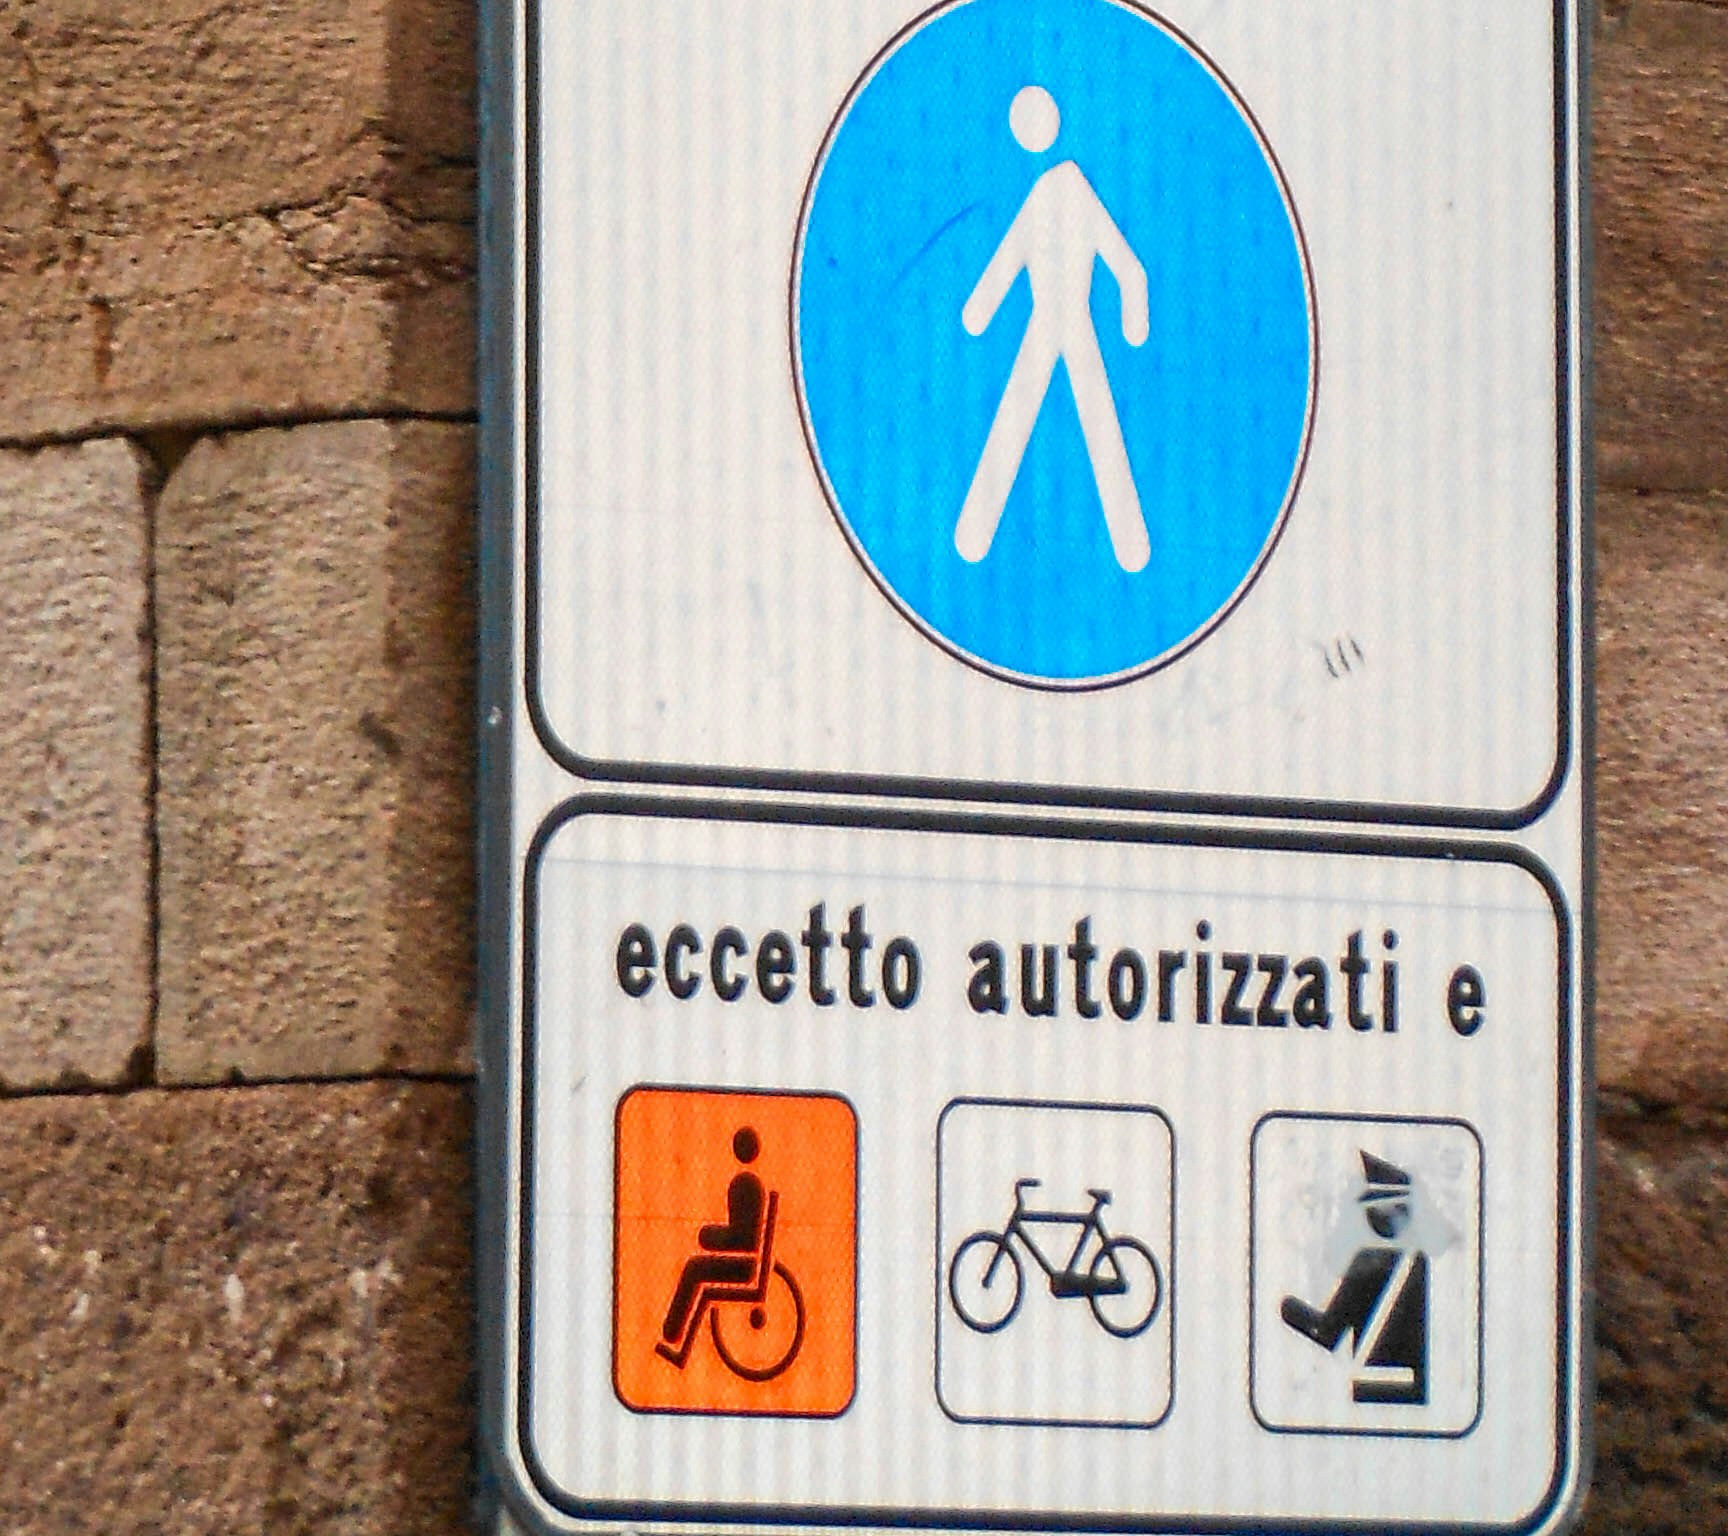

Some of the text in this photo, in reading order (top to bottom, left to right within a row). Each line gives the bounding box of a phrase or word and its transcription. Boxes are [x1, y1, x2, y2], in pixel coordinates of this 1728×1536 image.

[616, 903, 1487, 1037] eccetto autorizzati e
